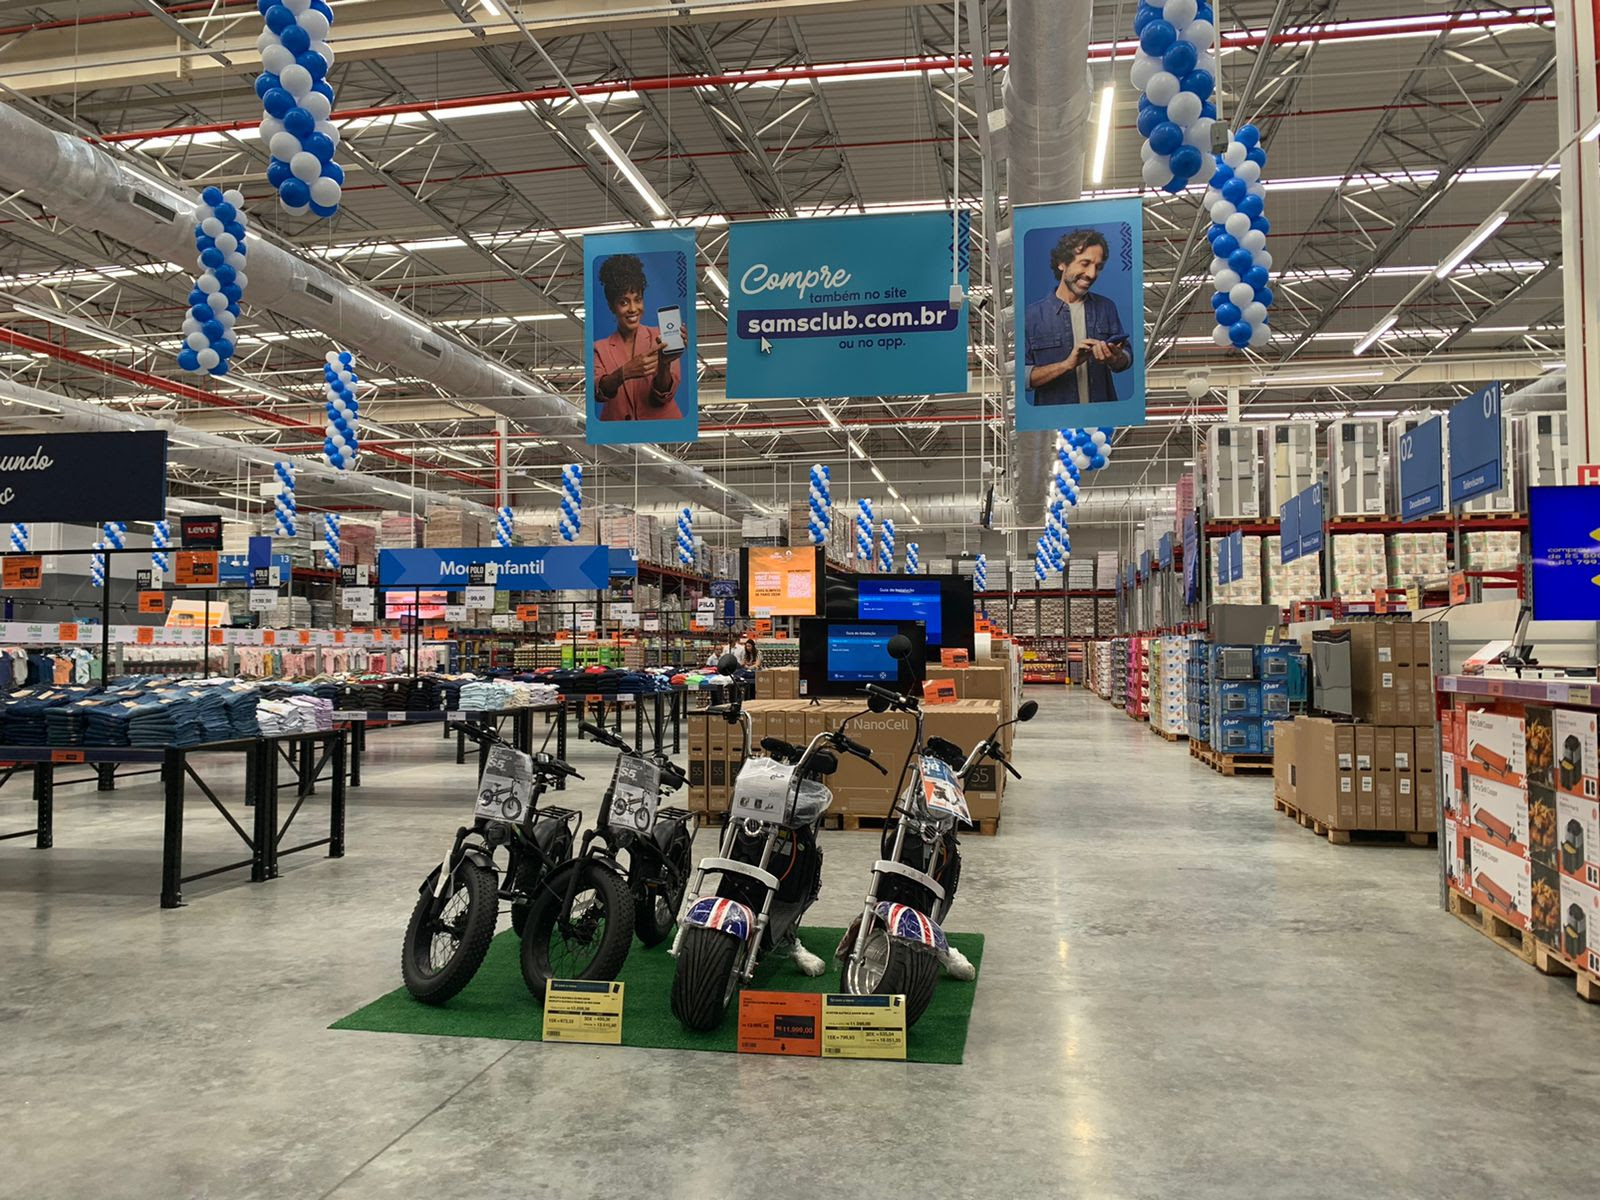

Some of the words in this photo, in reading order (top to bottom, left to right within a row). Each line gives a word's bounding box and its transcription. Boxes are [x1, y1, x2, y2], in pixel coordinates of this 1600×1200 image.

[740, 264, 851, 300] Compre
[810, 290, 860, 303] também
[864, 290, 880, 300] no
[884, 287, 907, 298] site
[748, 306, 947, 334] samsclub.com.br
[838, 338, 854, 349] ou
[858, 338, 874, 348] no
[878, 336, 906, 350] app.
[1483, 386, 1497, 418] 01
[0, 445, 54, 470] undo
[1401, 435, 1413, 462] 02
[490, 560, 544, 575] nfantil
[854, 718, 909, 730] NanoCell
[620, 766, 637, 778] S5
